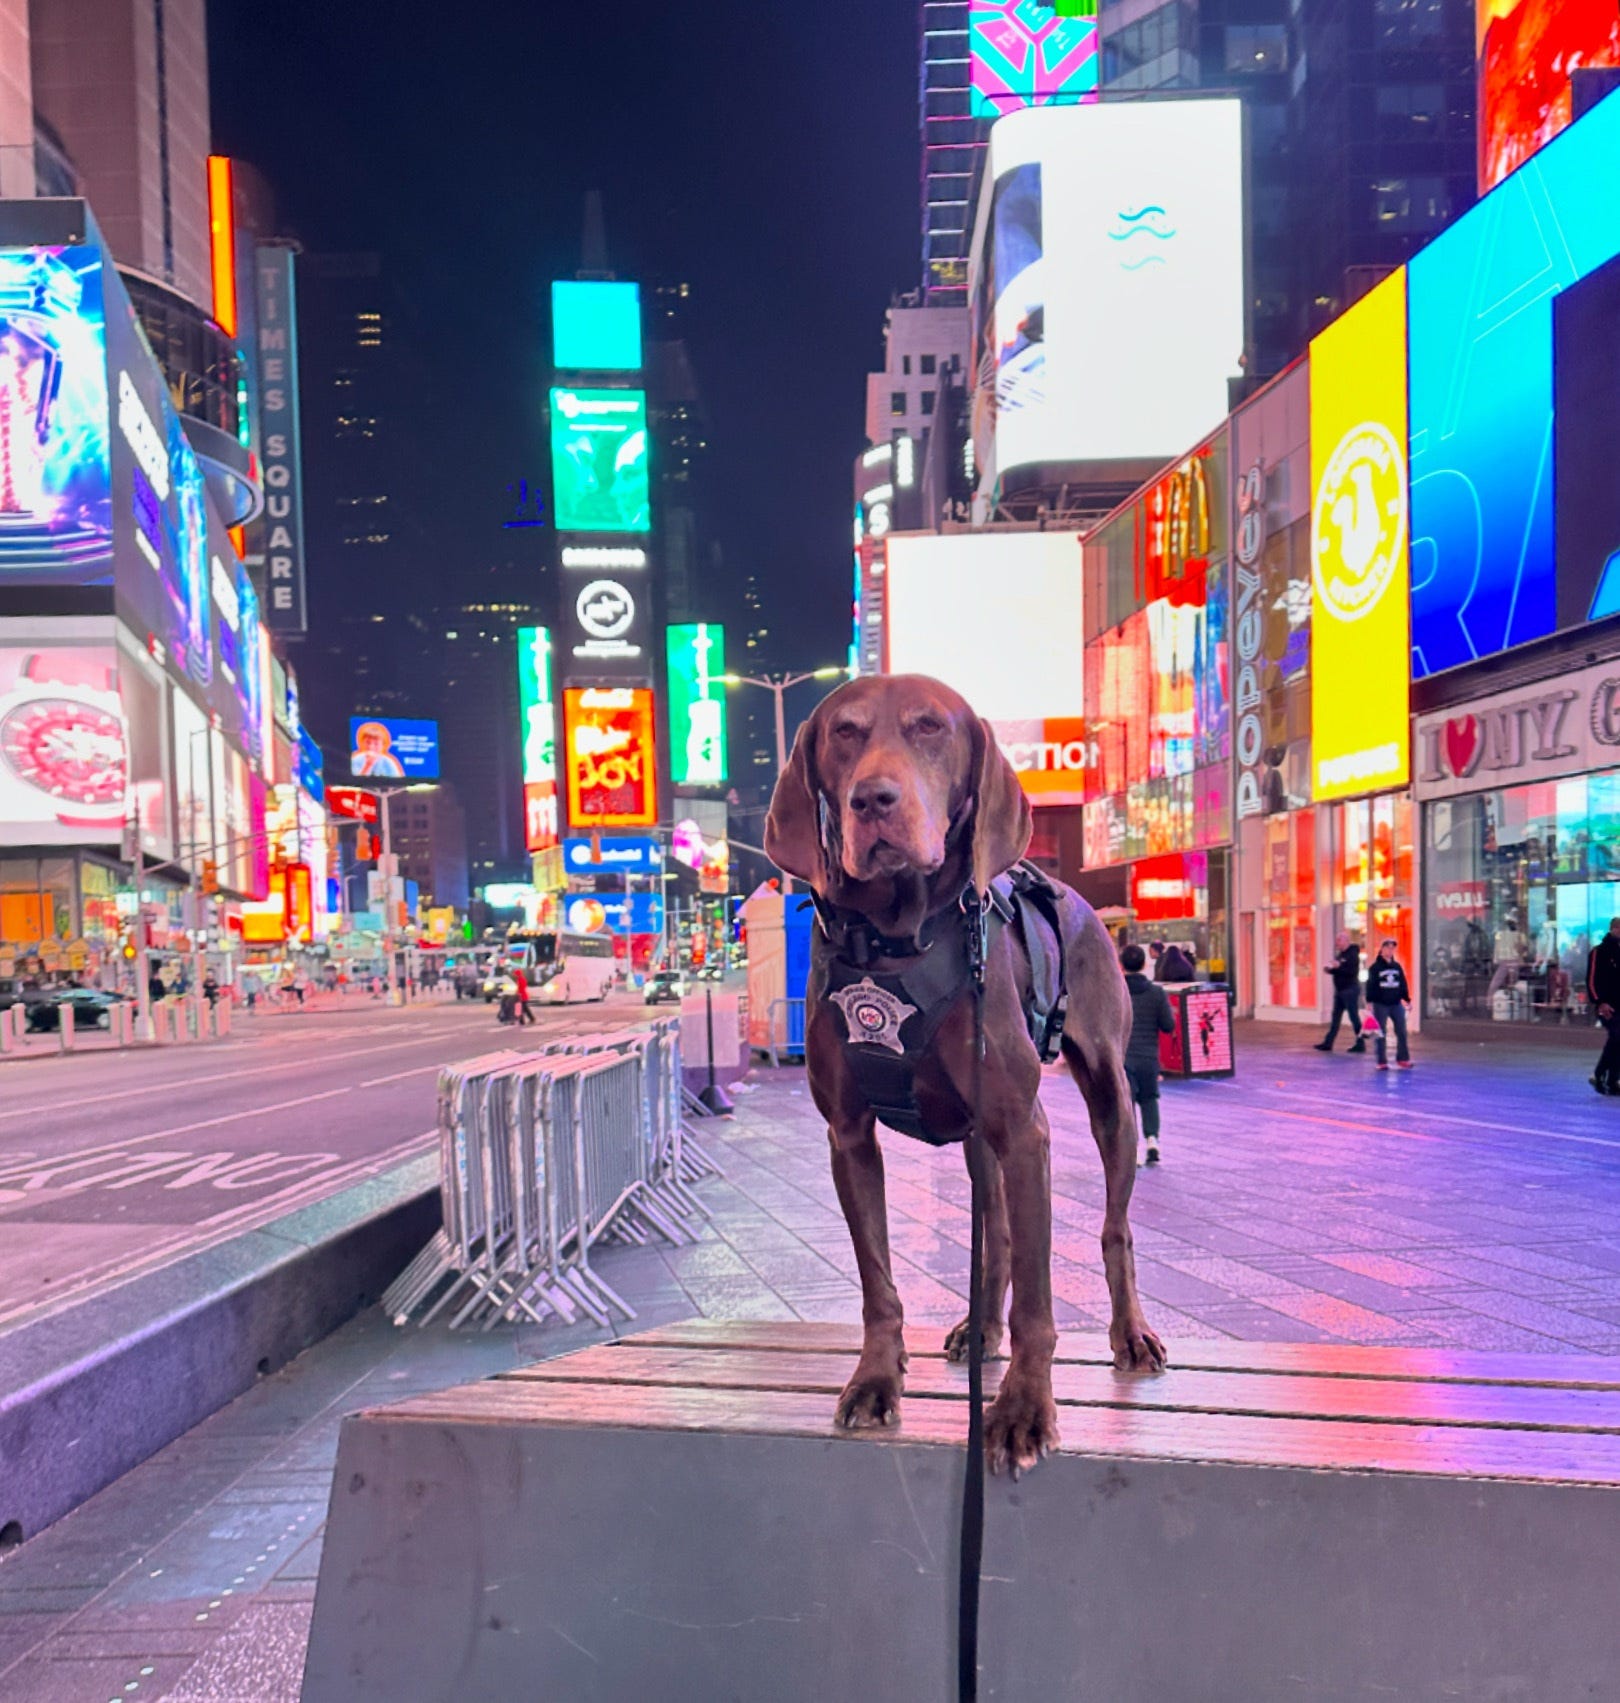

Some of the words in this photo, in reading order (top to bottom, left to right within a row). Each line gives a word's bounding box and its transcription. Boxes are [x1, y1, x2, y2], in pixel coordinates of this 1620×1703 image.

[259, 267, 286, 411] TIMES
[266, 434, 294, 610] SQUARE
[999, 741, 1100, 771] CTION
